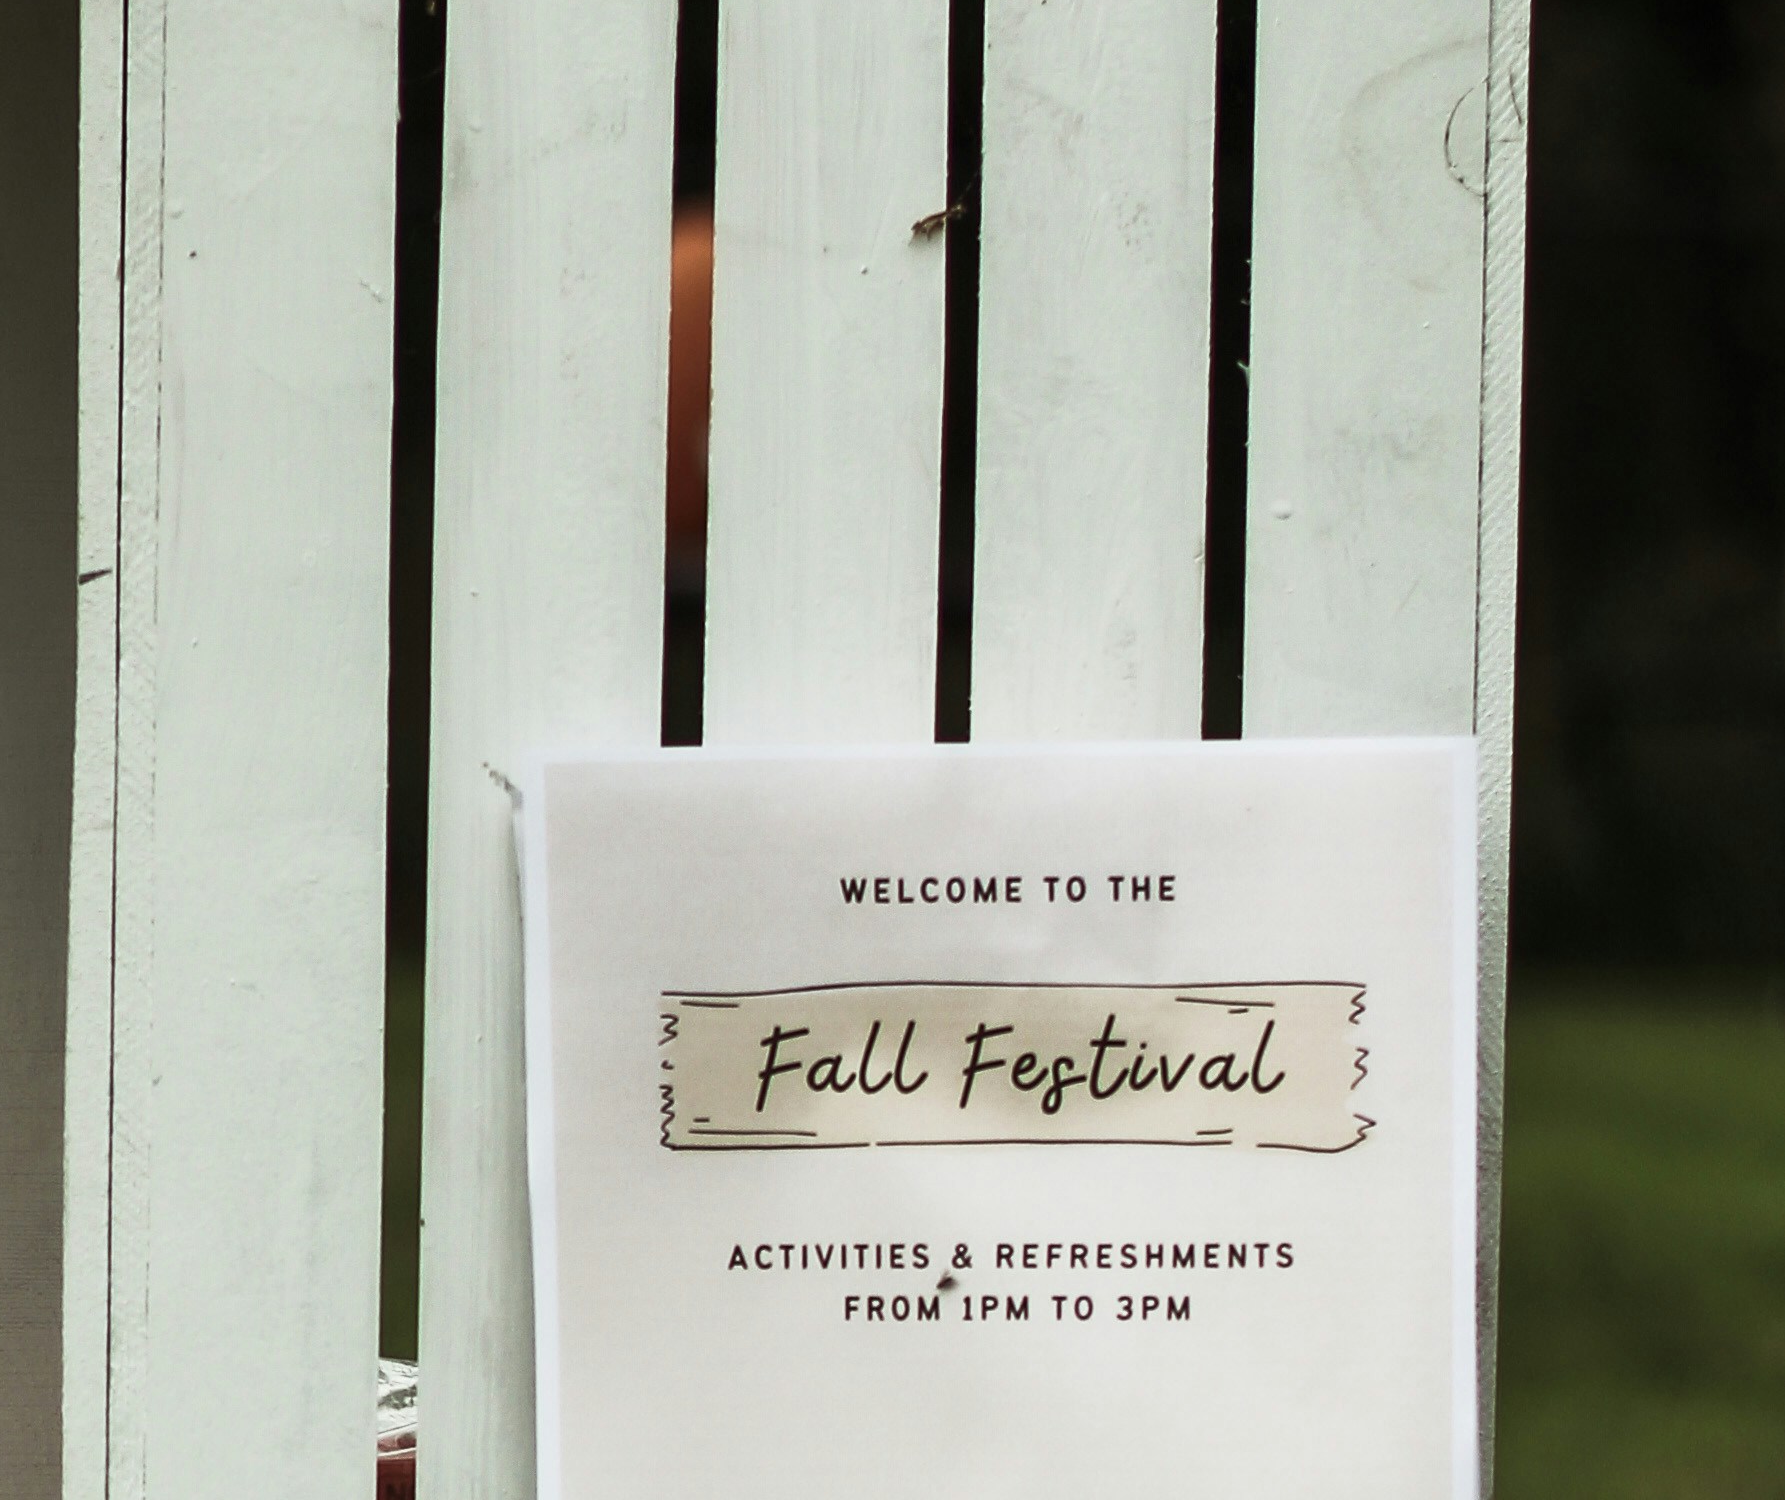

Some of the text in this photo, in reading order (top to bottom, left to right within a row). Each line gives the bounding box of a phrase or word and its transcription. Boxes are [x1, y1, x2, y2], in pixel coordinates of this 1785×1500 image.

[839, 875, 1176, 904] WELCOME TO THE
[755, 1013, 1286, 1114] Fall Festival
[728, 1242, 1294, 1271] ACTIVITIES & REFRESHMENTS
[844, 1295, 1190, 1322] FROM 1PM TO 3PM
